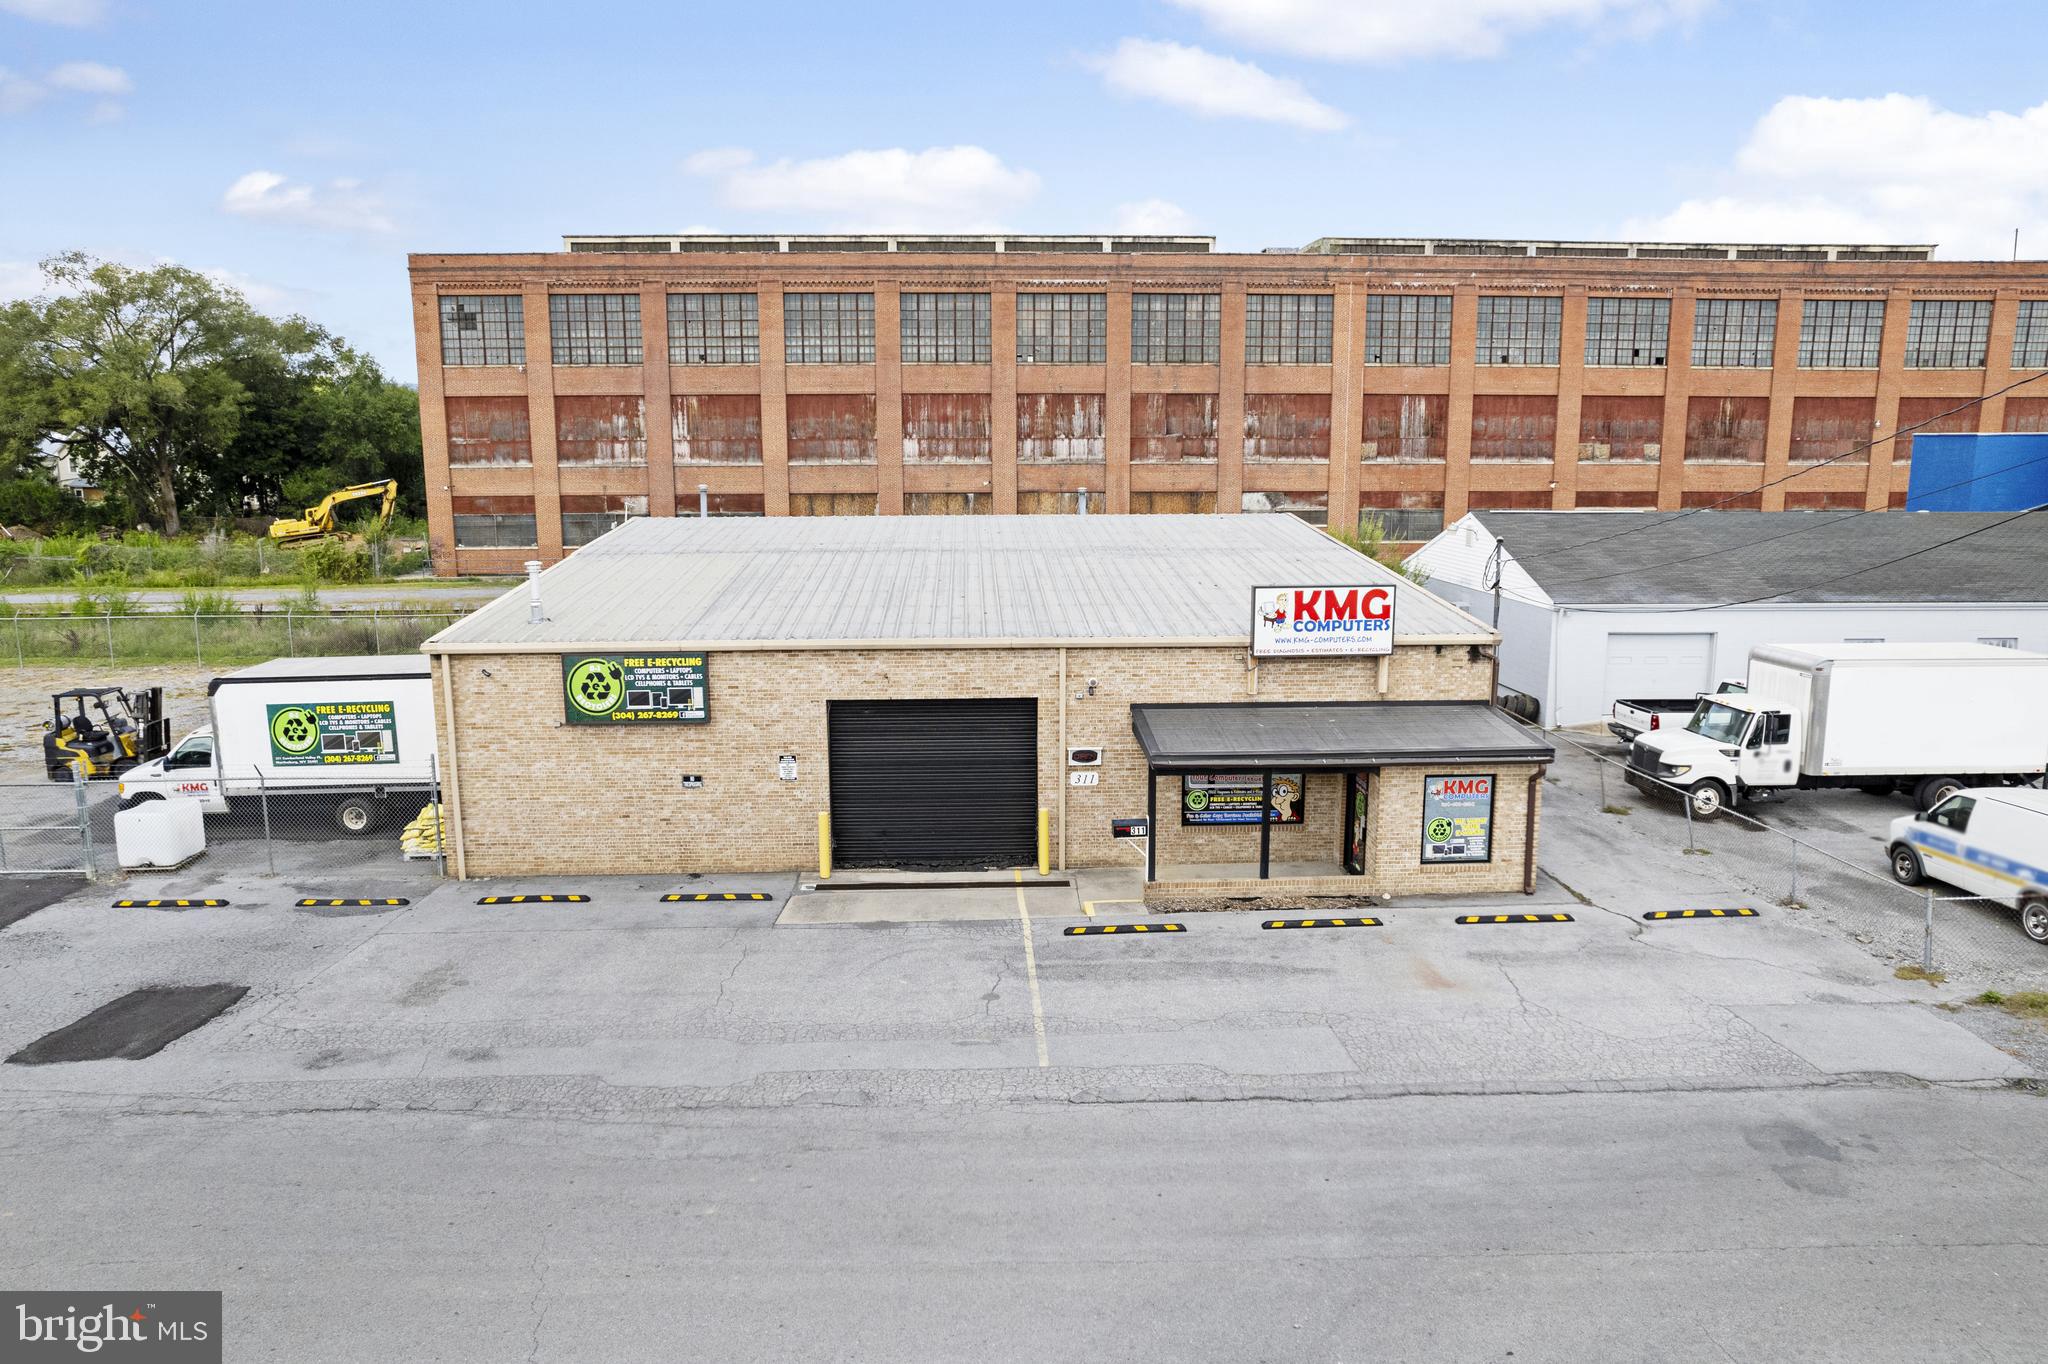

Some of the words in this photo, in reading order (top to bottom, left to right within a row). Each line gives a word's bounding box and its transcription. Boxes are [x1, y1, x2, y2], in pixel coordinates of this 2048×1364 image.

[1293, 588, 1391, 622] KMG
[1293, 619, 1390, 632] COMPUTERS
[1274, 636, 1373, 644] WWW.KMG-COMPUTERS.COM
[624, 658, 645, 667] FREE
[647, 657, 703, 667] E-RECYCLING
[316, 705, 336, 714] FREE
[338, 704, 391, 714] E-RECYCLING
[612, 711, 635, 720] (304)
[637, 711, 679, 719] 267-8269
[324, 755, 341, 763] (304)
[343, 754, 373, 763] 267-8269
[1074, 774, 1095, 784] 311
[181, 783, 208, 791] KMG
[1443, 779, 1489, 794] KMG
[1131, 826, 1146, 835] 311
